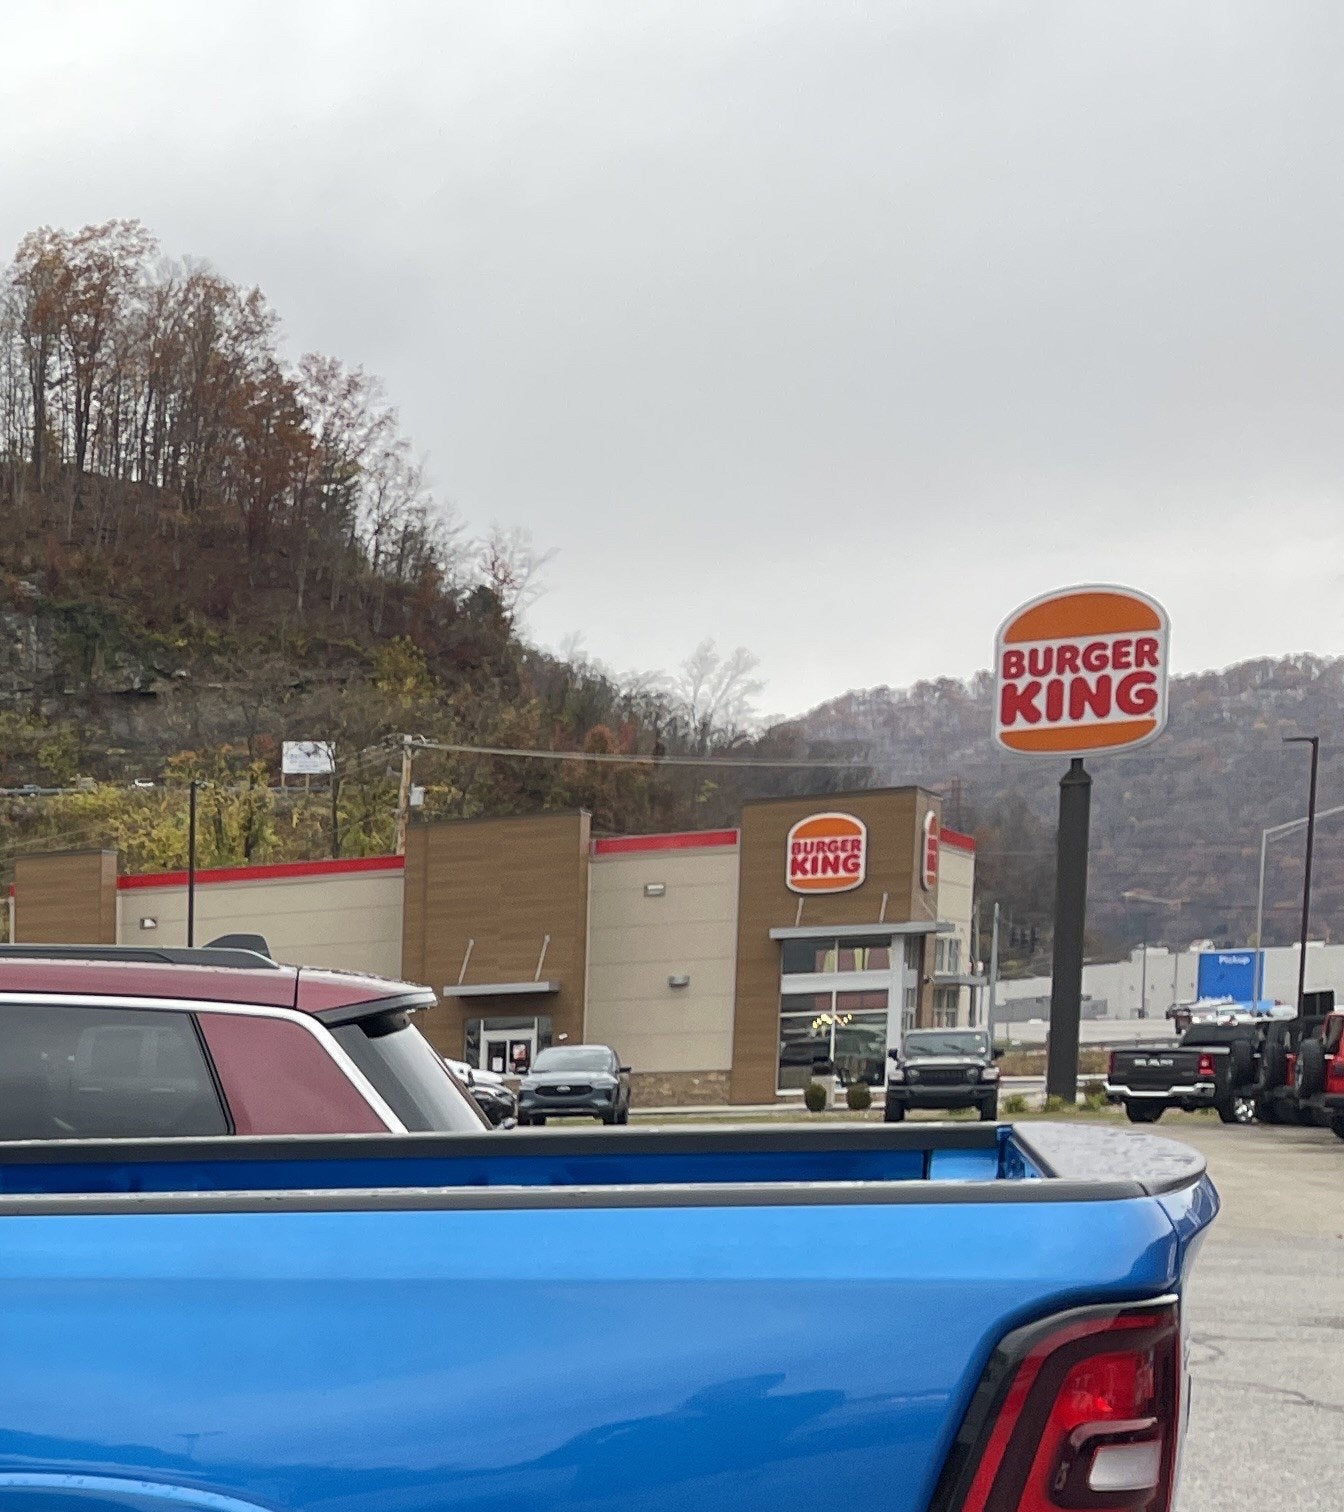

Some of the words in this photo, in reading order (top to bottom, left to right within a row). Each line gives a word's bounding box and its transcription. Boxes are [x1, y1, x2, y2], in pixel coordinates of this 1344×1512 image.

[1002, 637, 1159, 680] BURGER
[1000, 671, 1158, 726] KING
[791, 839, 862, 856] BURGER
[790, 854, 861, 876] KING
[1218, 955, 1251, 966] Pickup
